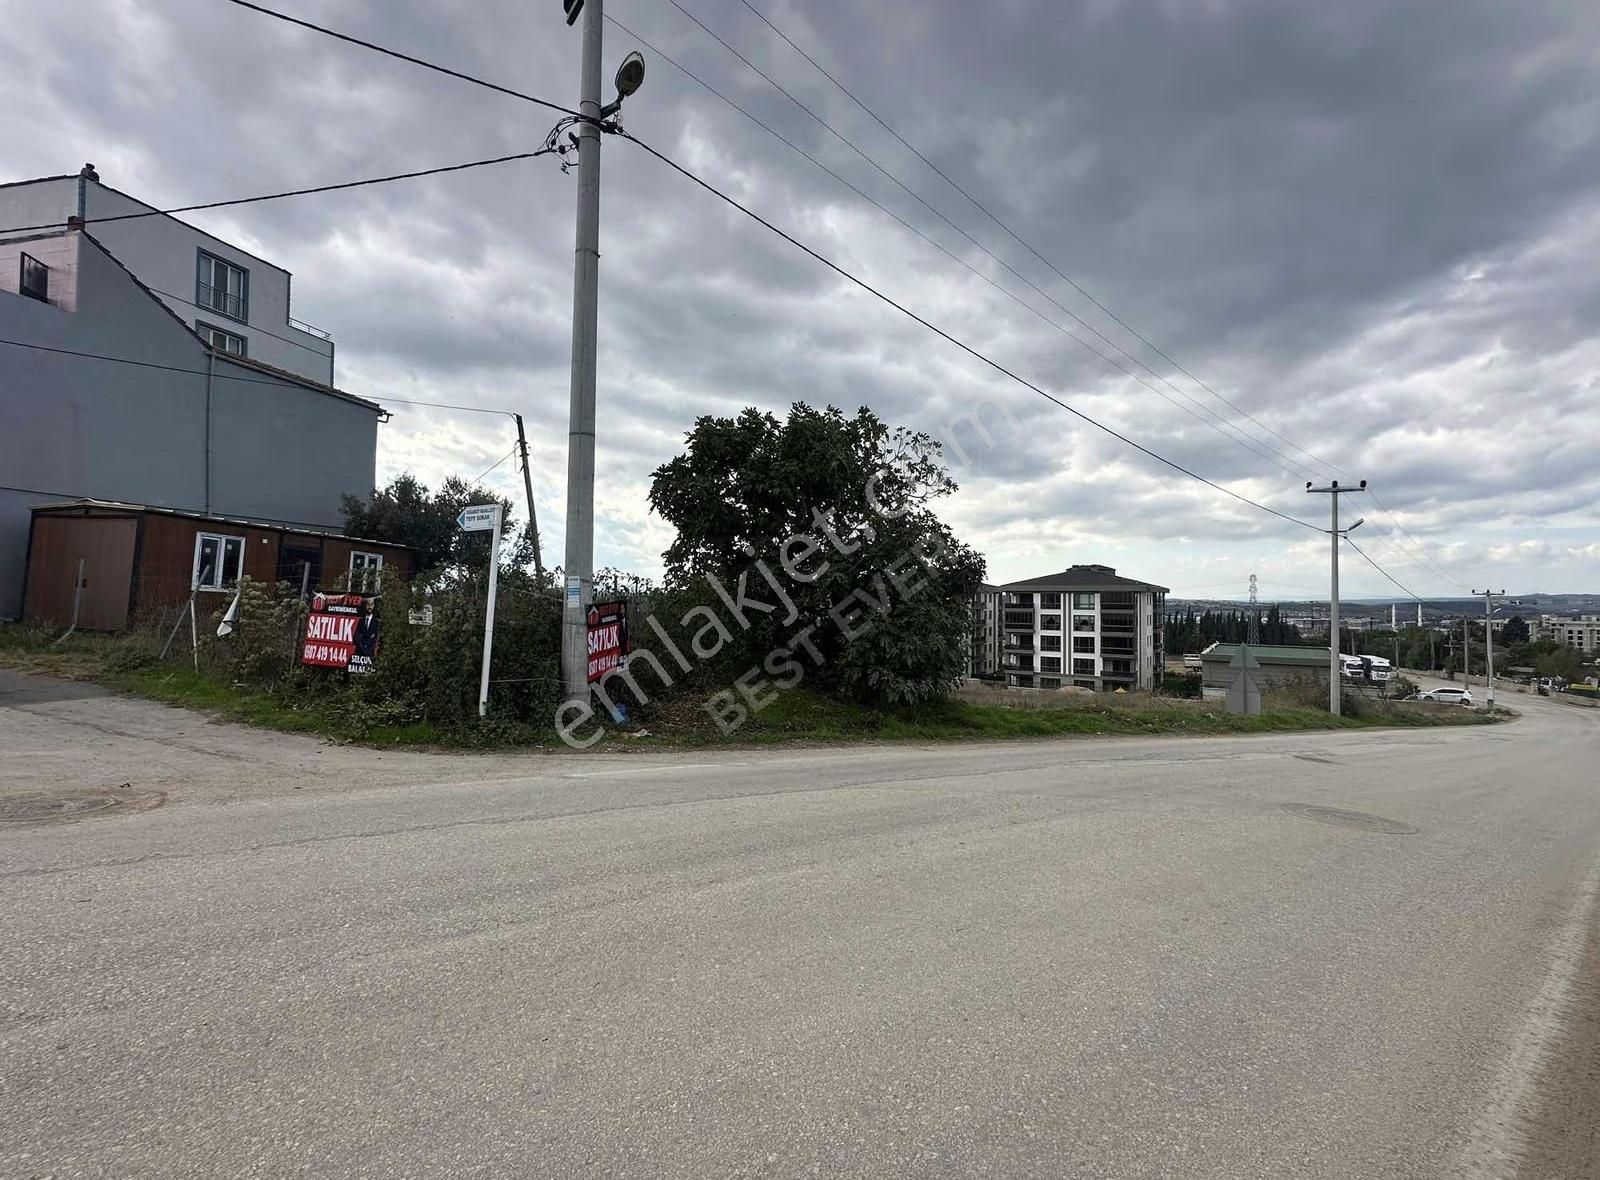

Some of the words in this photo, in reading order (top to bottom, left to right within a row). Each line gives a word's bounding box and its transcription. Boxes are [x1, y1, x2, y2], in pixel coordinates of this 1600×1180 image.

[307, 615, 355, 642] SATILIK
[588, 626, 619, 655] SATILIK
[316, 646, 328, 661] 419
[329, 647, 338, 662] 14
[338, 648, 348, 663] 44
